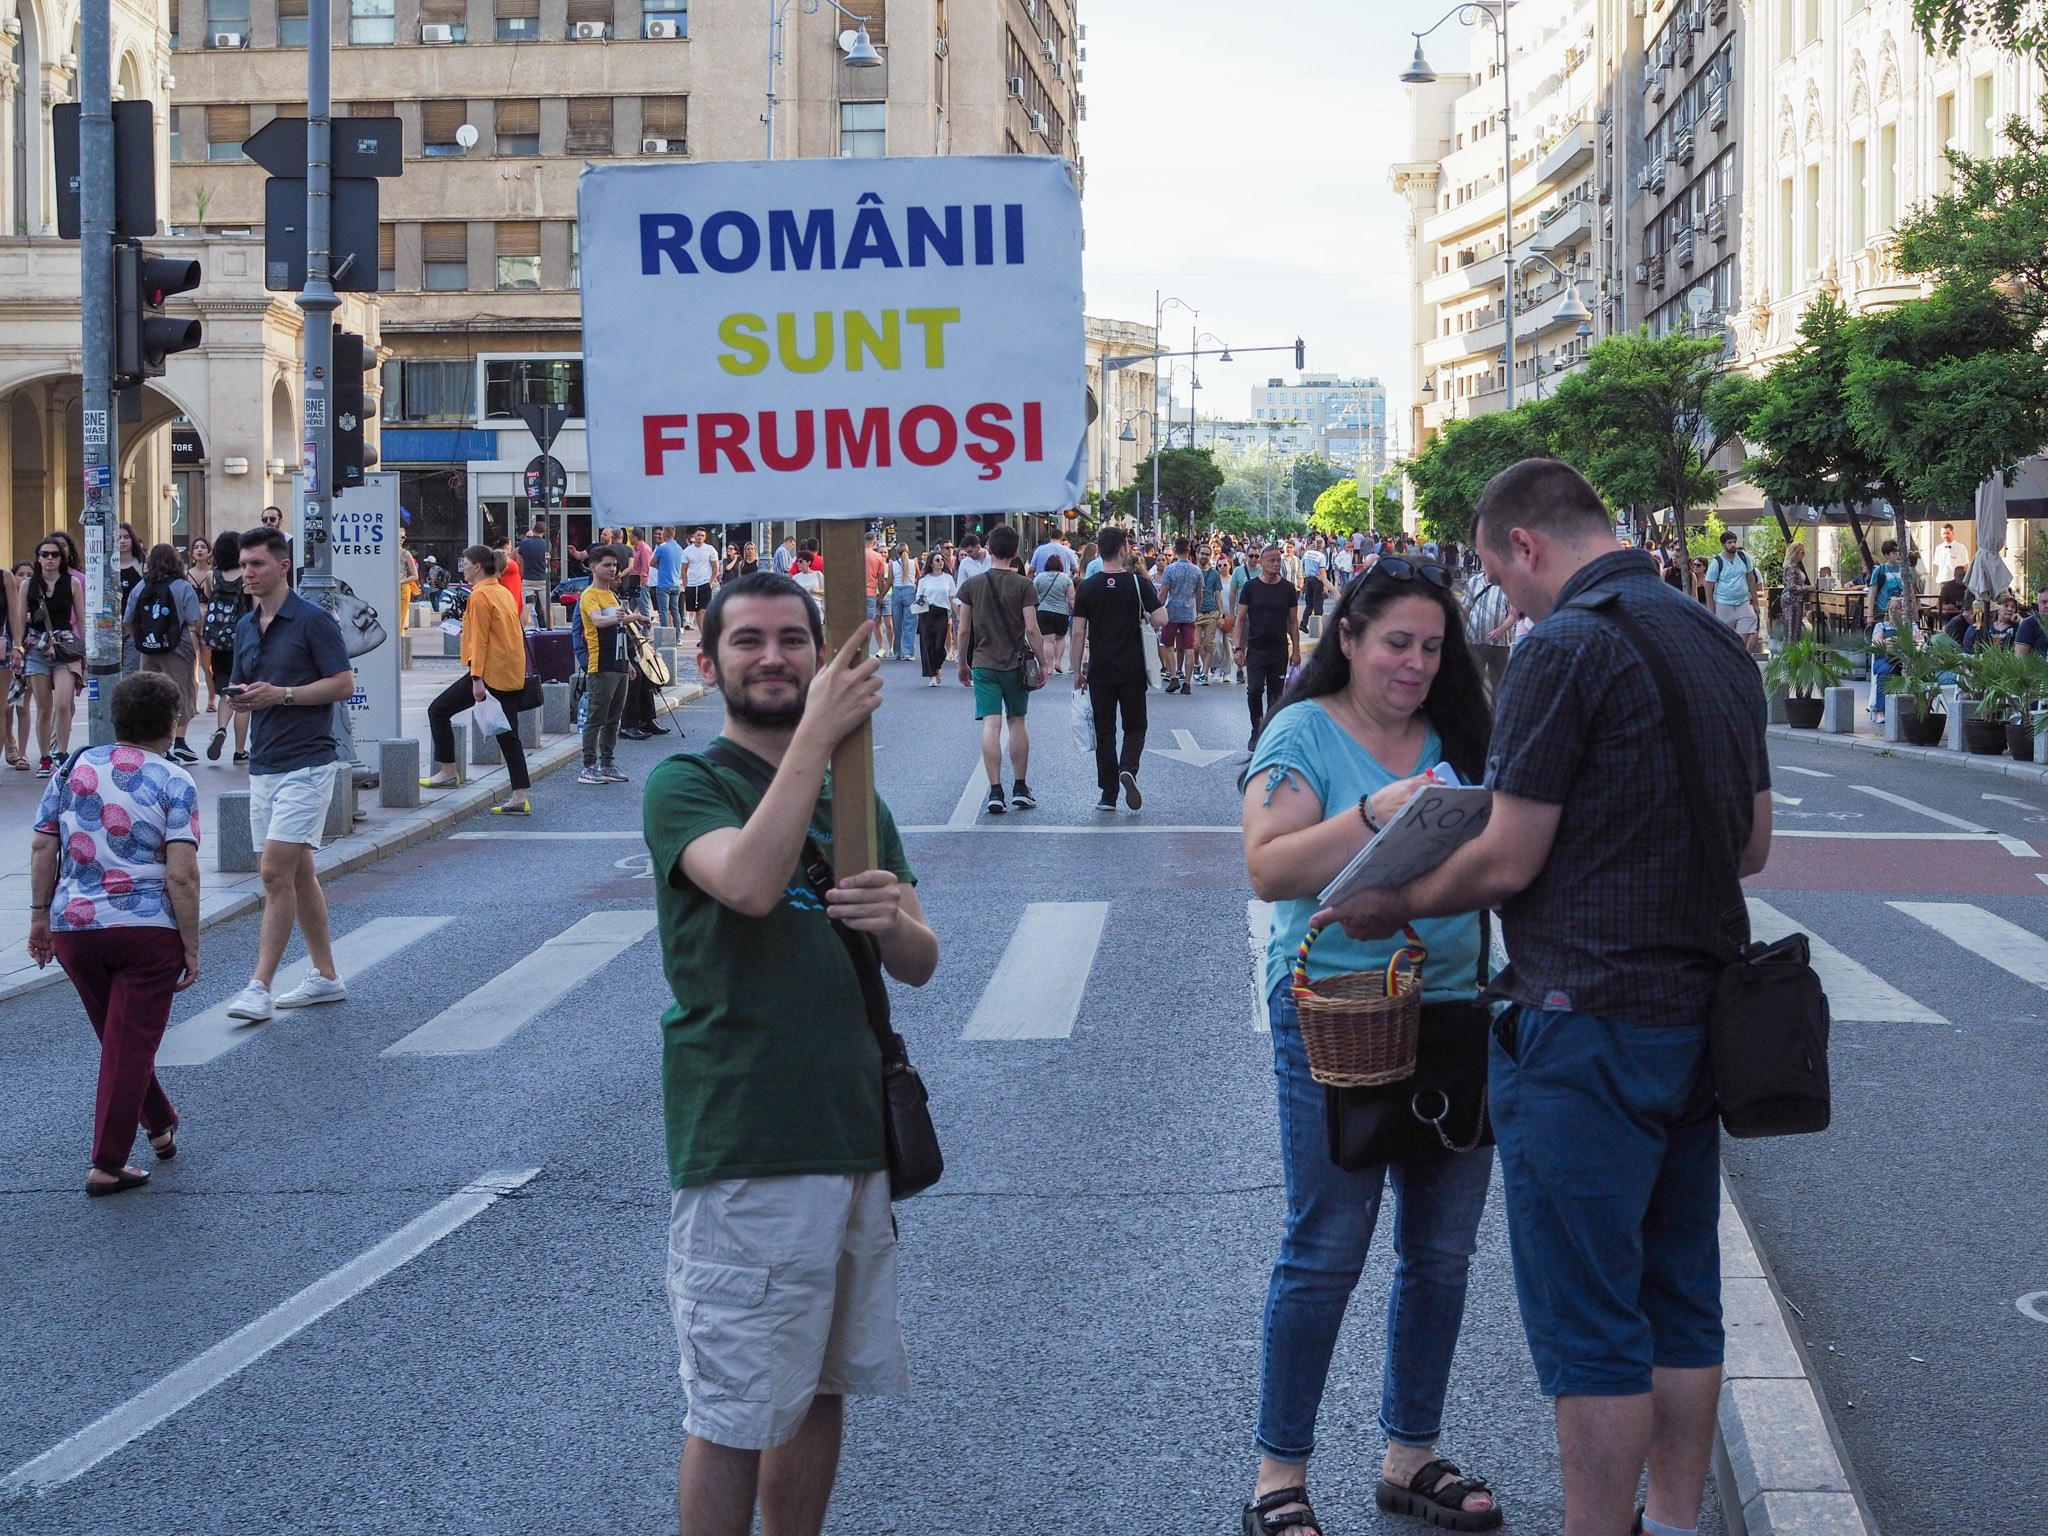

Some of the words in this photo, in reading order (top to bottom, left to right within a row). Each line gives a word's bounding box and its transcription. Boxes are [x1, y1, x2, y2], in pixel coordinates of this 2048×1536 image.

[639, 192, 1025, 275] ROMÂNII
[717, 307, 961, 376] SUNT
[84, 412, 105, 426] BNE
[305, 400, 324, 411] BNE
